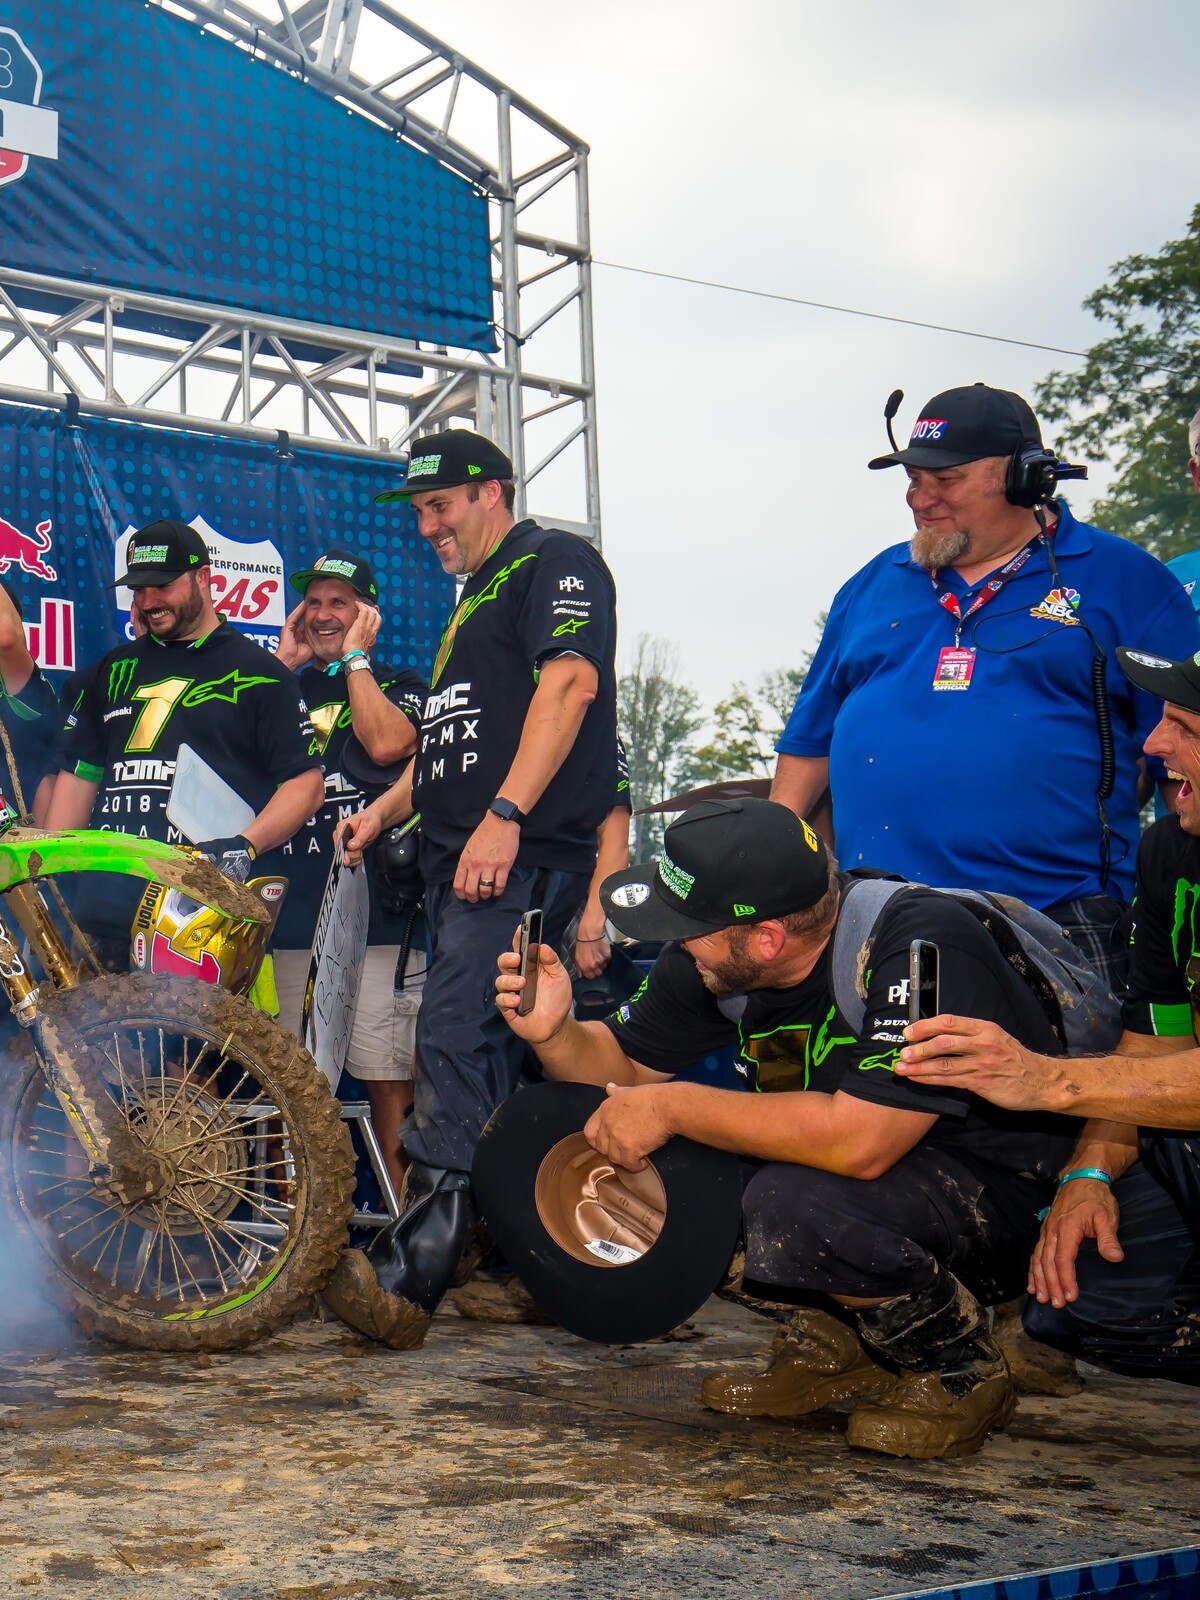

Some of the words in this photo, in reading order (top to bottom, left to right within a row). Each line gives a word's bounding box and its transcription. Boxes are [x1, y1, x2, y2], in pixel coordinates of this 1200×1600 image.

[208, 558, 282, 576] PERFORMANCE
[559, 576, 585, 592] PPG
[209, 574, 279, 620] CAS
[558, 599, 591, 607] DUNLOP
[1029, 606, 1081, 626] Sports
[1038, 601, 1078, 620] NBC
[423, 682, 472, 720] MAC
[103, 706, 132, 723] Kawasaki
[124, 676, 195, 753] 1
[112, 759, 177, 782] TOMA
[101, 794, 167, 813] 2018-
[266, 887, 283, 896] BELL
[312, 872, 338, 969] TOMAC
[316, 893, 350, 1026] BACK
[882, 1019, 910, 1027] DUN
